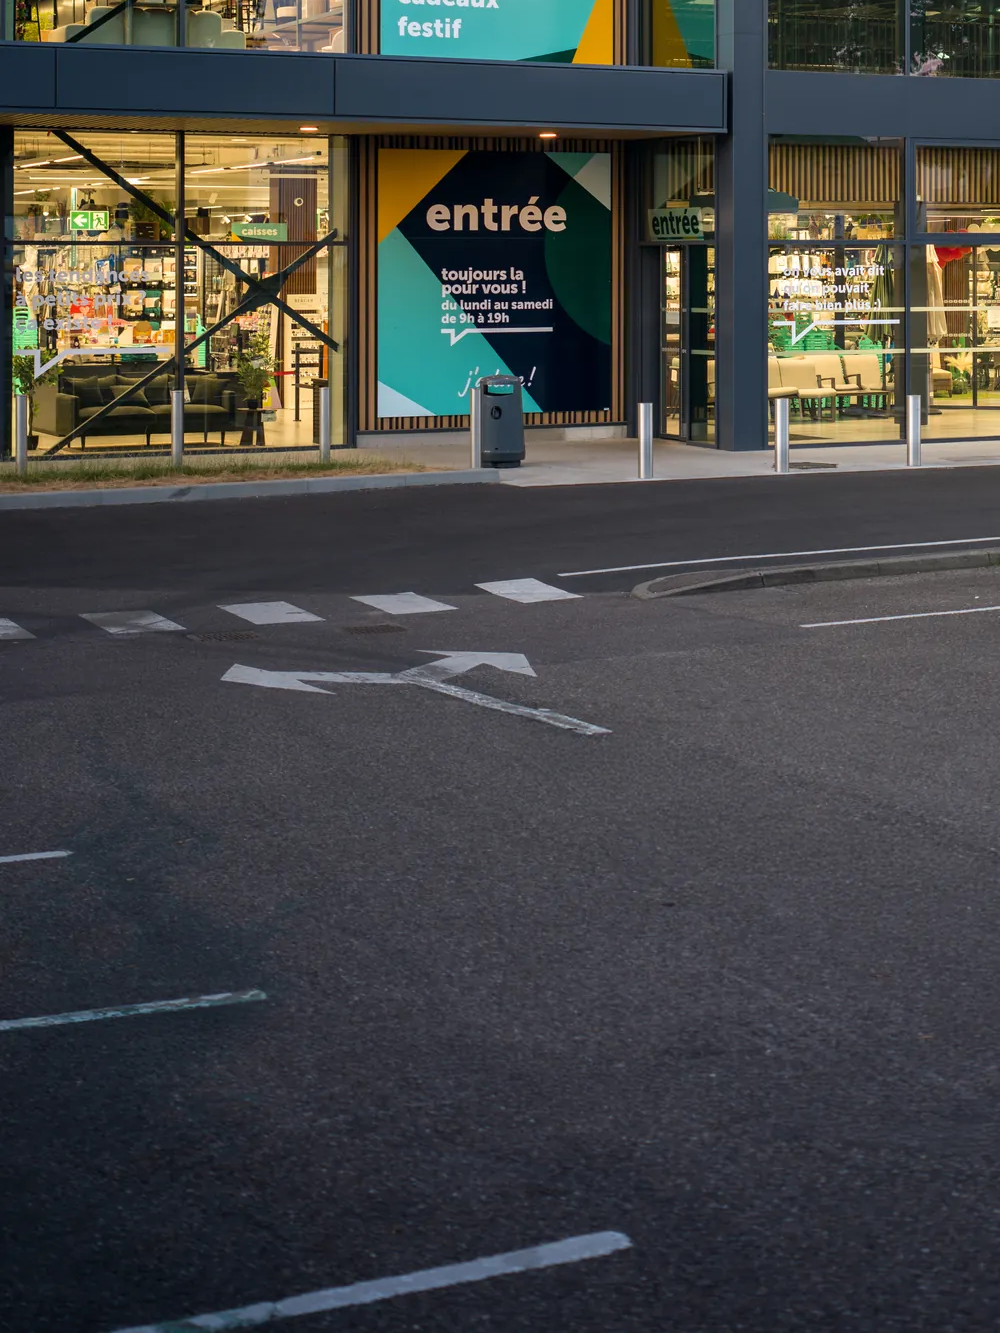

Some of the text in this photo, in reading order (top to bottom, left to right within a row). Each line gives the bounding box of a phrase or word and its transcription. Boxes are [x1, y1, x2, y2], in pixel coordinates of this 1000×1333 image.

[397, 16, 462, 39] festif
[426, 196, 567, 232] entrée
[652, 209, 700, 235] entrée
[241, 227, 278, 236] caisses
[16, 267, 150, 283] les tendances
[441, 267, 524, 283] toujours la
[783, 265, 885, 277] on vous avait dit
[442, 283, 479, 298] pour
[481, 283, 518, 294] vous
[822, 282, 870, 296] pouvait
[16, 291, 26, 306] à
[32, 291, 89, 310] petits
[94, 290, 131, 309] prix
[441, 299, 553, 311] du lundi au samedi
[783, 300, 813, 311] faire
[815, 300, 842, 311] bien
[845, 299, 871, 313] plus
[16, 318, 37, 334] ça
[43, 316, 101, 330] existe
[441, 312, 509, 324] de 9h à 19h
